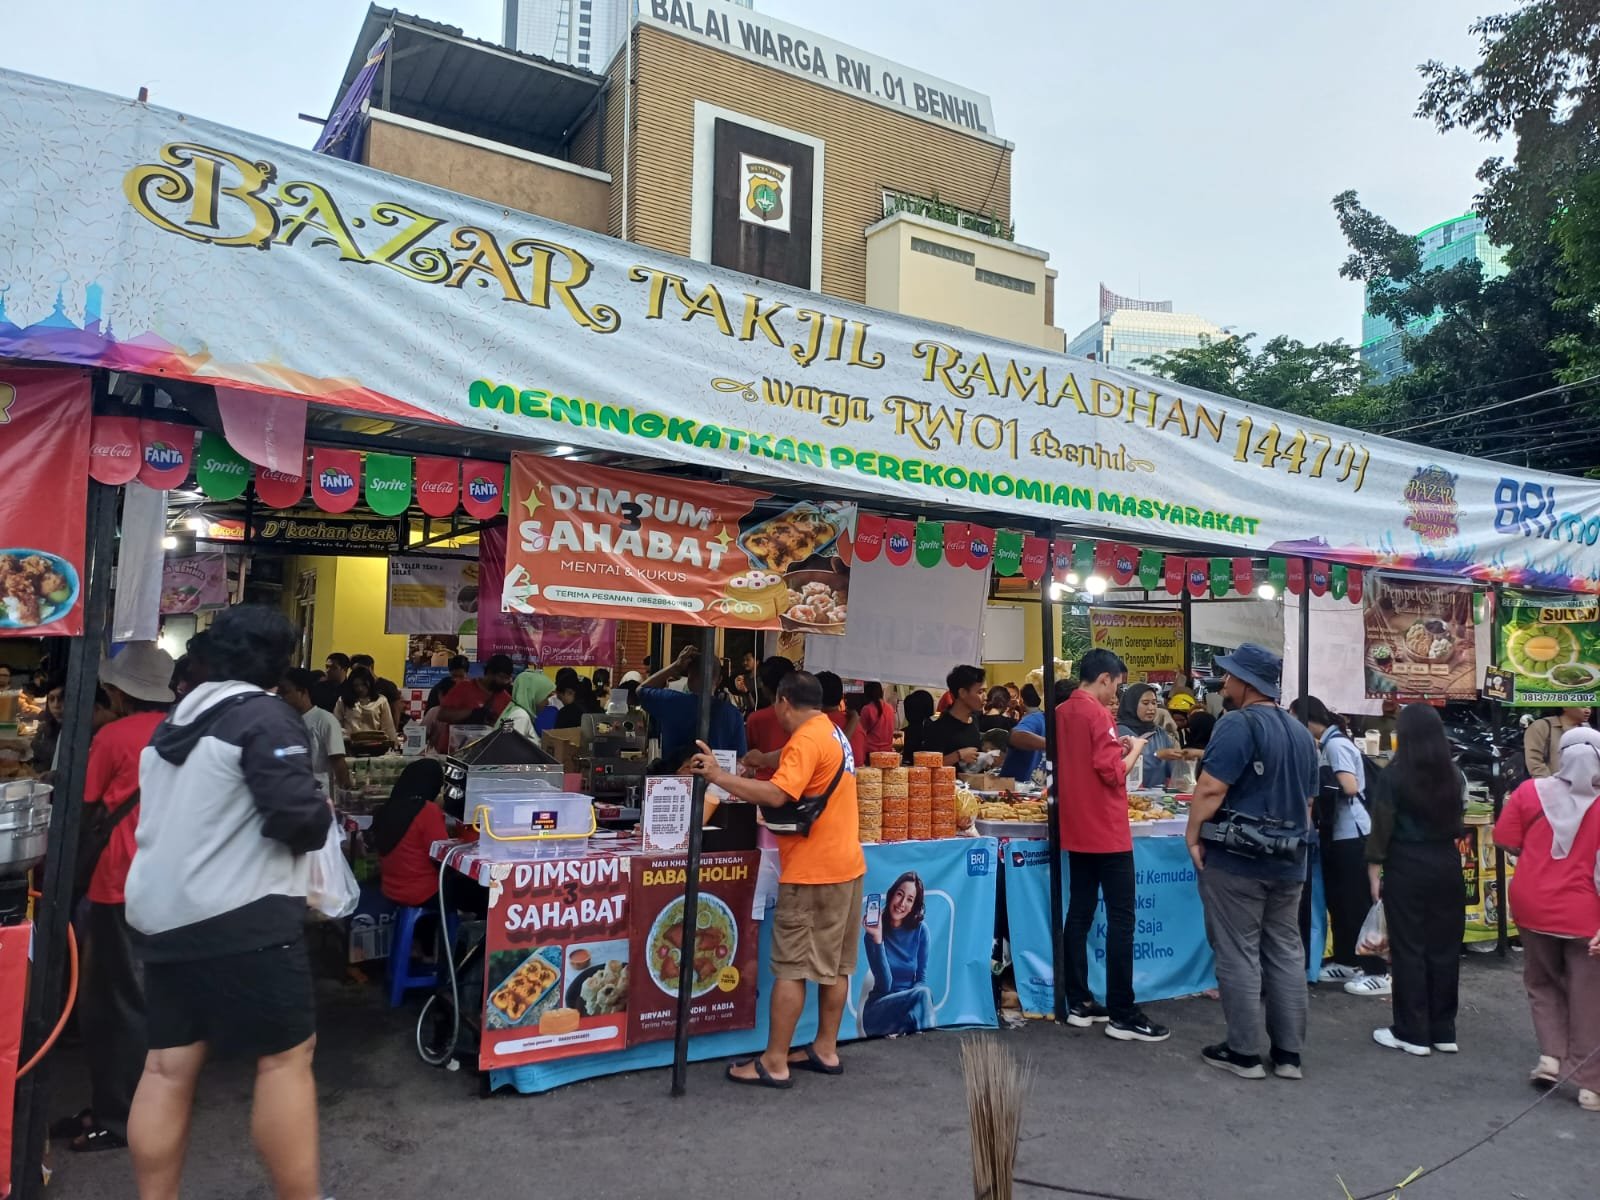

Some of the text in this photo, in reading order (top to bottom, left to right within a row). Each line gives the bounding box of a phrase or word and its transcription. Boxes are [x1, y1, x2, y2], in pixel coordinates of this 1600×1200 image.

[651, 0, 730, 44] BALAI
[738, 20, 828, 79] WARGA
[912, 83, 988, 132] BENHIL
[123, 141, 621, 333] BAZAR
[628, 265, 885, 369] TAKJIL
[912, 339, 1227, 443] RAMADHAN
[203, 458, 245, 475] Sprite
[469, 380, 1260, 536] MENINGKATKAN PEREKONOMIAN MASYARAKAT
[369, 477, 407, 492] Sprite
[550, 484, 712, 531] DIMSUM
[620, 502, 643, 532] 3
[348, 523, 397, 543] Steak
[519, 521, 729, 571] SAHABAT
[918, 540, 940, 550] Sprite
[997, 547, 1019, 560] Sprite
[560, 560, 688, 583] MENTAI & KUKUS
[555, 589, 590, 600] TERIMA
[591, 592, 633, 603] PESANAN
[1382, 583, 1424, 603] Pempek
[1543, 607, 1597, 621] SULTAN
[1106, 636, 1124, 650] Ayam
[1124, 636, 1153, 650] Gorengan
[1125, 653, 1155, 667] Panggang
[651, 860, 669, 868] NASI
[714, 856, 743, 865] TENGAH
[970, 853, 986, 865] BRI
[514, 858, 620, 890] DIMSUM
[642, 868, 688, 887] BABA
[562, 881, 579, 905] 3
[504, 894, 626, 931] SAHABAT
[1137, 917, 1163, 937] Saja
[639, 1009, 671, 1021] BIRYANI
